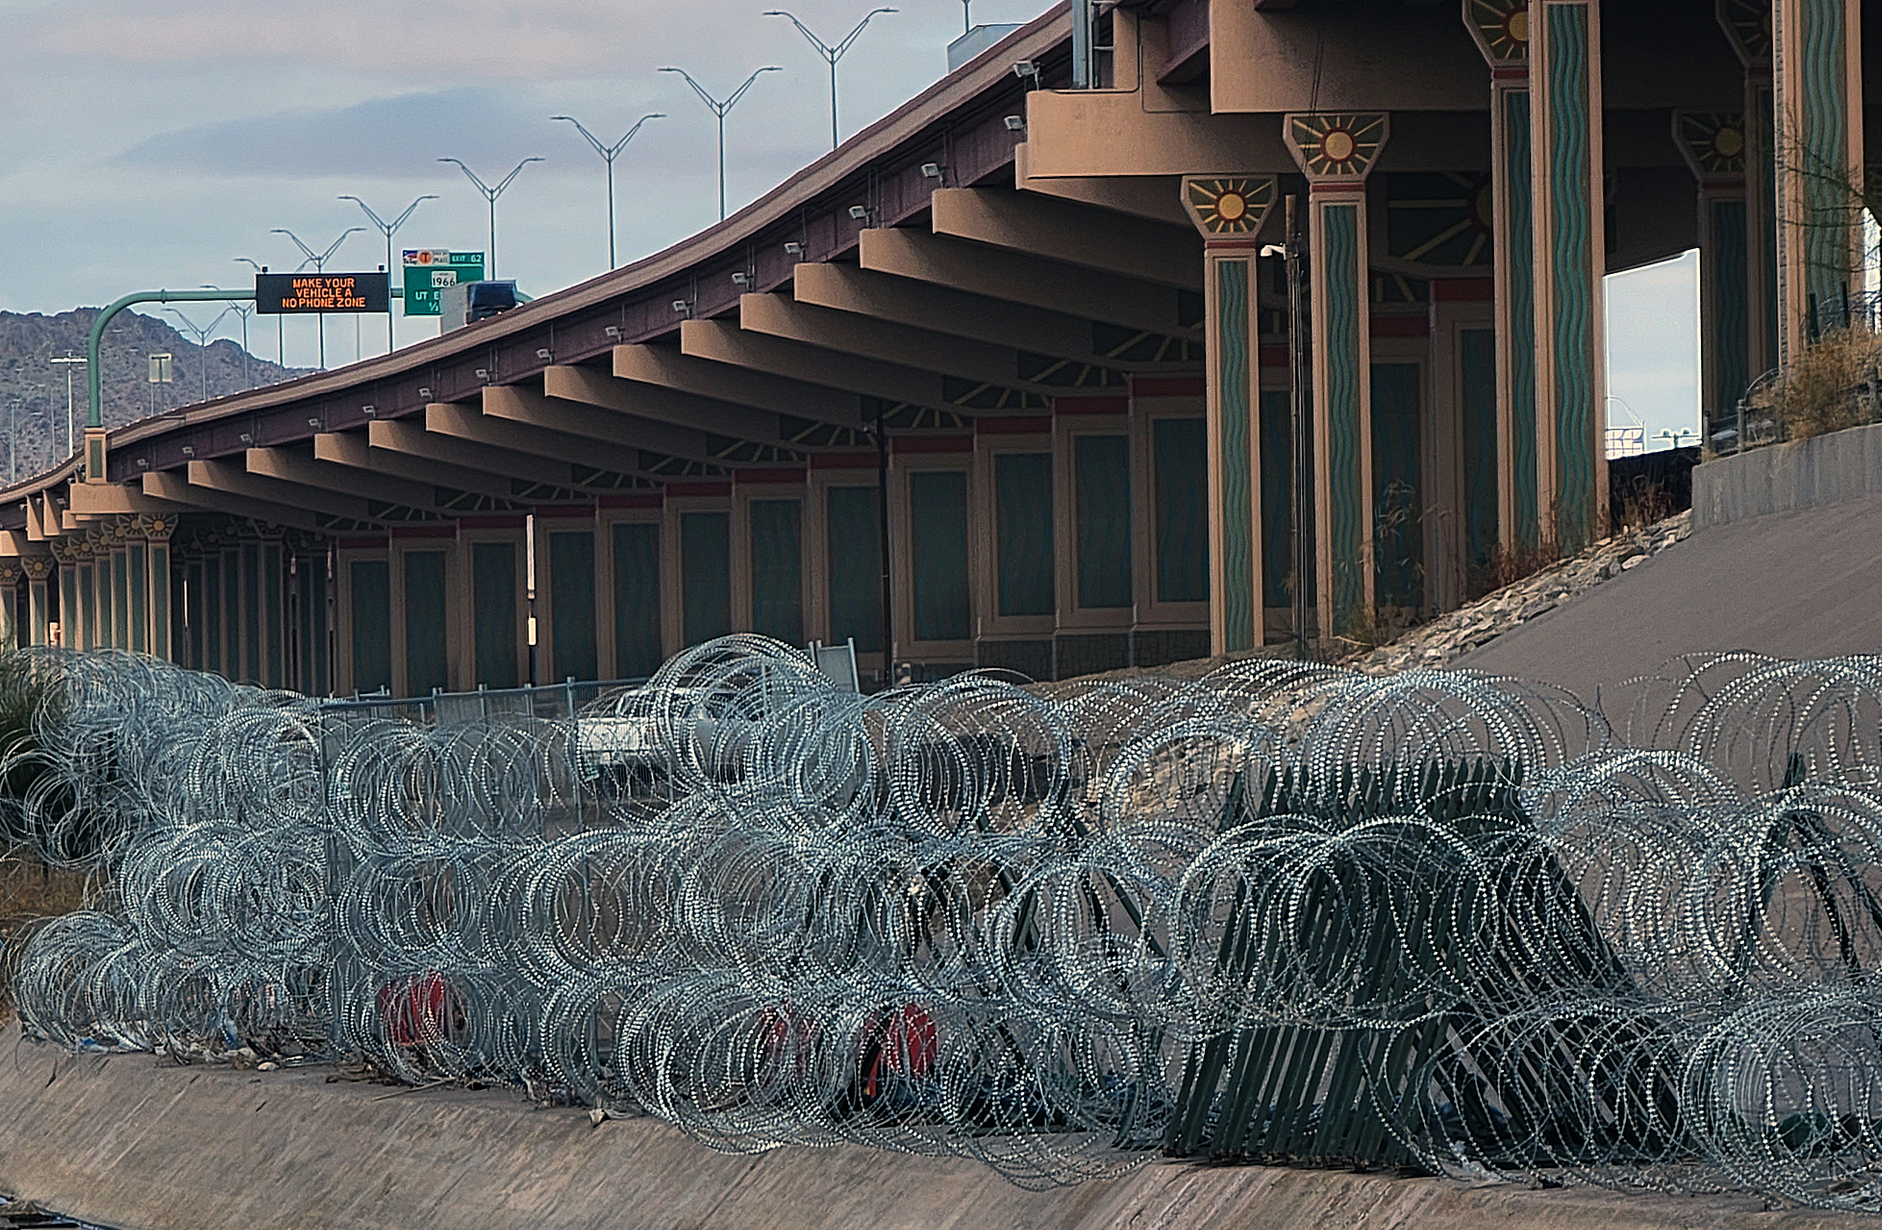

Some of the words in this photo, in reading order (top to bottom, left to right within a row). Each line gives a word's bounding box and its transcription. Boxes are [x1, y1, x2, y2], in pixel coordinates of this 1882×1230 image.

[451, 254, 466, 262] EXIT
[470, 254, 482, 263] 62
[292, 278, 323, 288] MAKE
[325, 278, 355, 288] YOUR
[432, 276, 456, 287] 1966
[296, 288, 342, 298] VEHICLE
[344, 288, 352, 297] A
[415, 291, 429, 301] UT
[282, 298, 297, 308] NO
[298, 298, 335, 308] PHONE
[336, 297, 366, 308] ZONE
